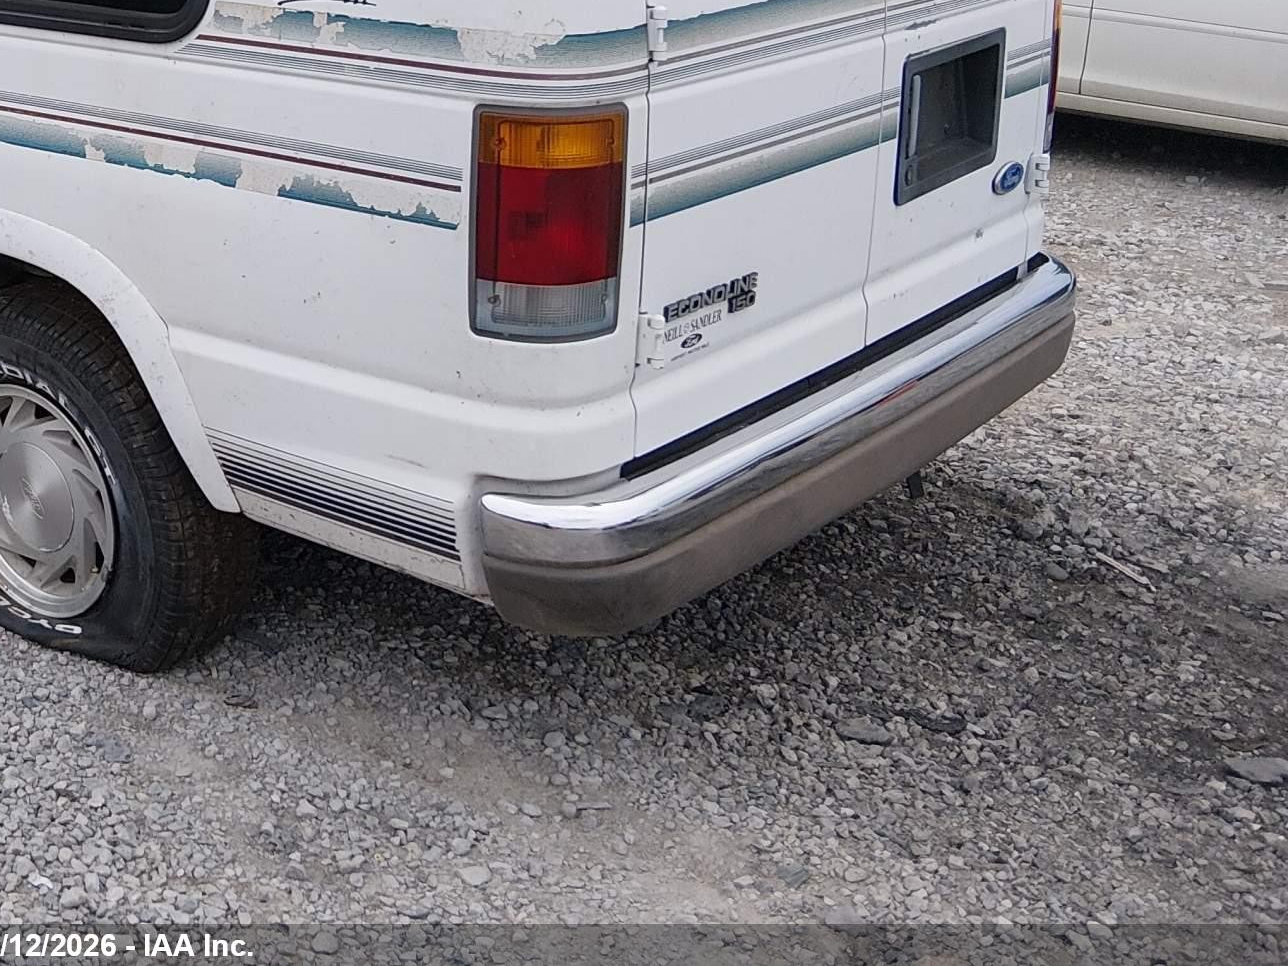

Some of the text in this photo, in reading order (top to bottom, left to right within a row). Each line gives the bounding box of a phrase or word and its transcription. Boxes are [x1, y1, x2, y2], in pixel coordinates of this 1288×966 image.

[663, 272, 759, 323] ECONOLINE
[727, 291, 757, 314] 150
[690, 309, 722, 333] SANDLER
